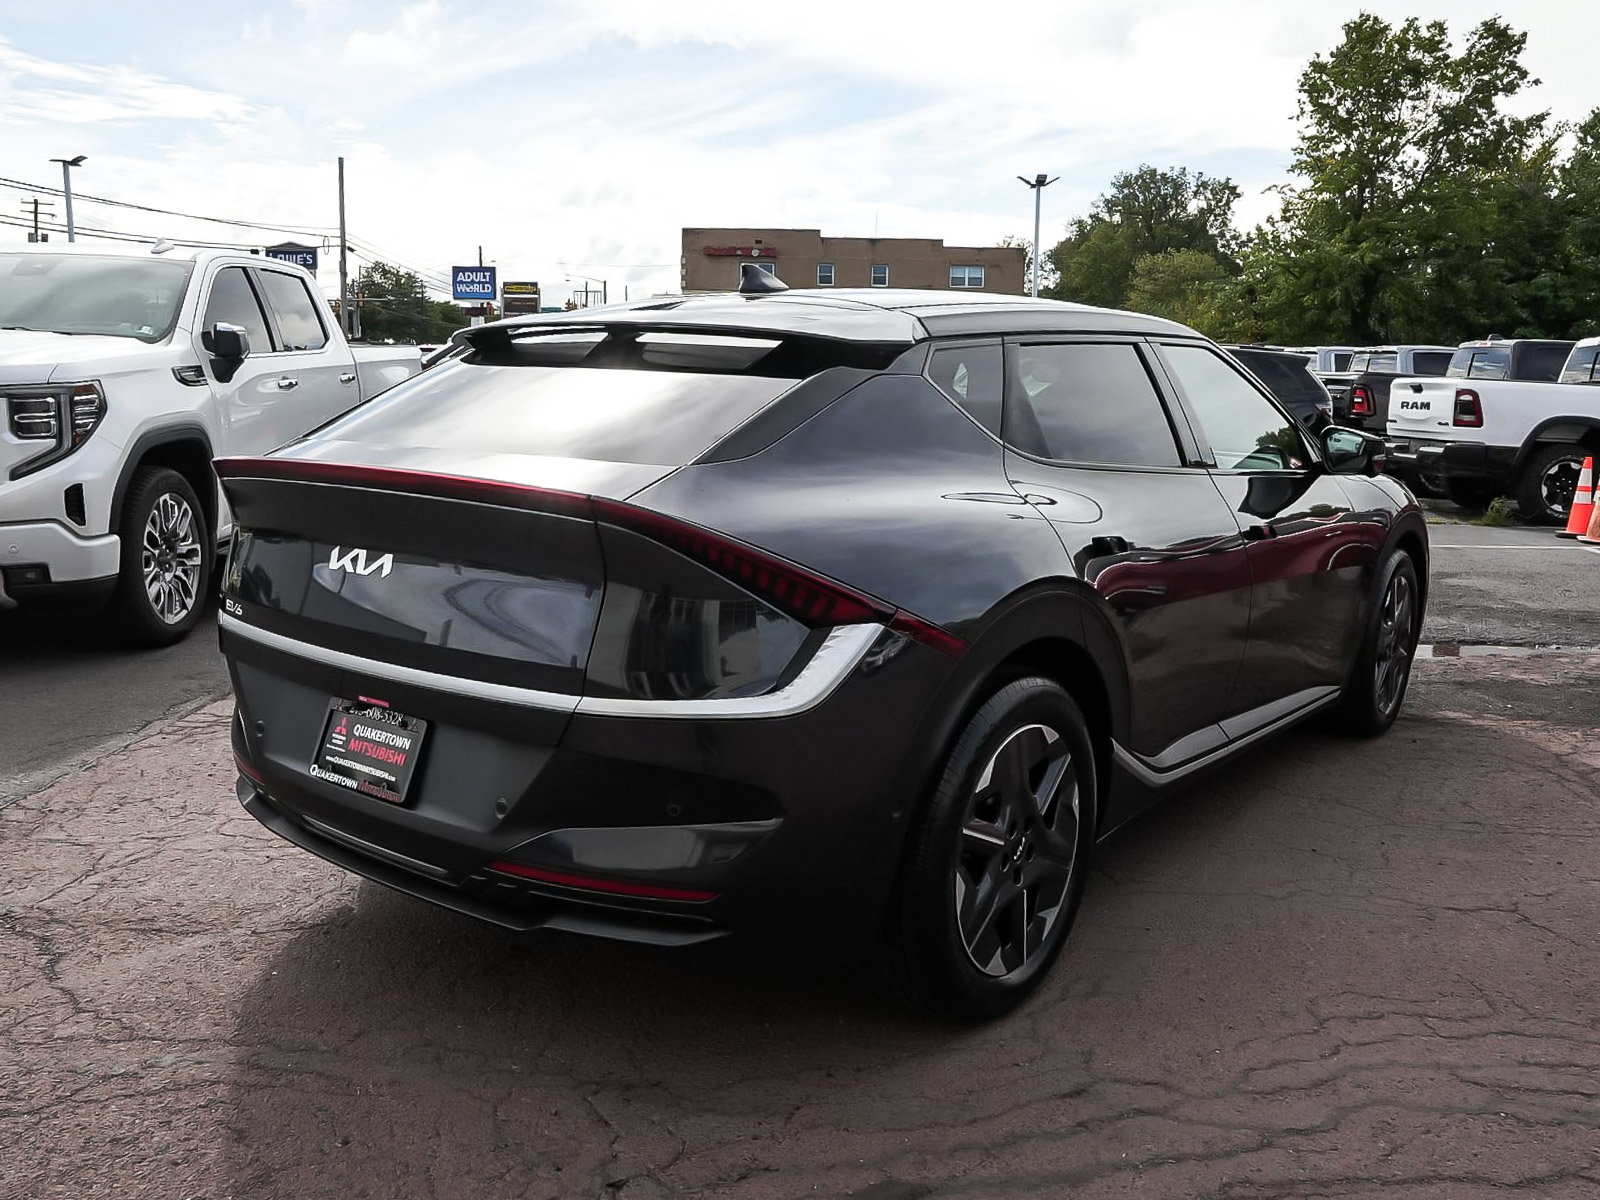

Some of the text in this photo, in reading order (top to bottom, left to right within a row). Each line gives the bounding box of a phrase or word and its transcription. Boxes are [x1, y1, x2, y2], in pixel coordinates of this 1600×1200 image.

[456, 271, 491, 282] ADULT
[456, 283, 492, 293] WORLD
[1400, 401, 1431, 411] RAM
[329, 545, 394, 579] KIA
[226, 599, 243, 615] EV6
[353, 724, 412, 750] QUAKERTOWN
[348, 739, 407, 766] MITSUBISHI
[309, 764, 359, 790] QUAKERTOWN
